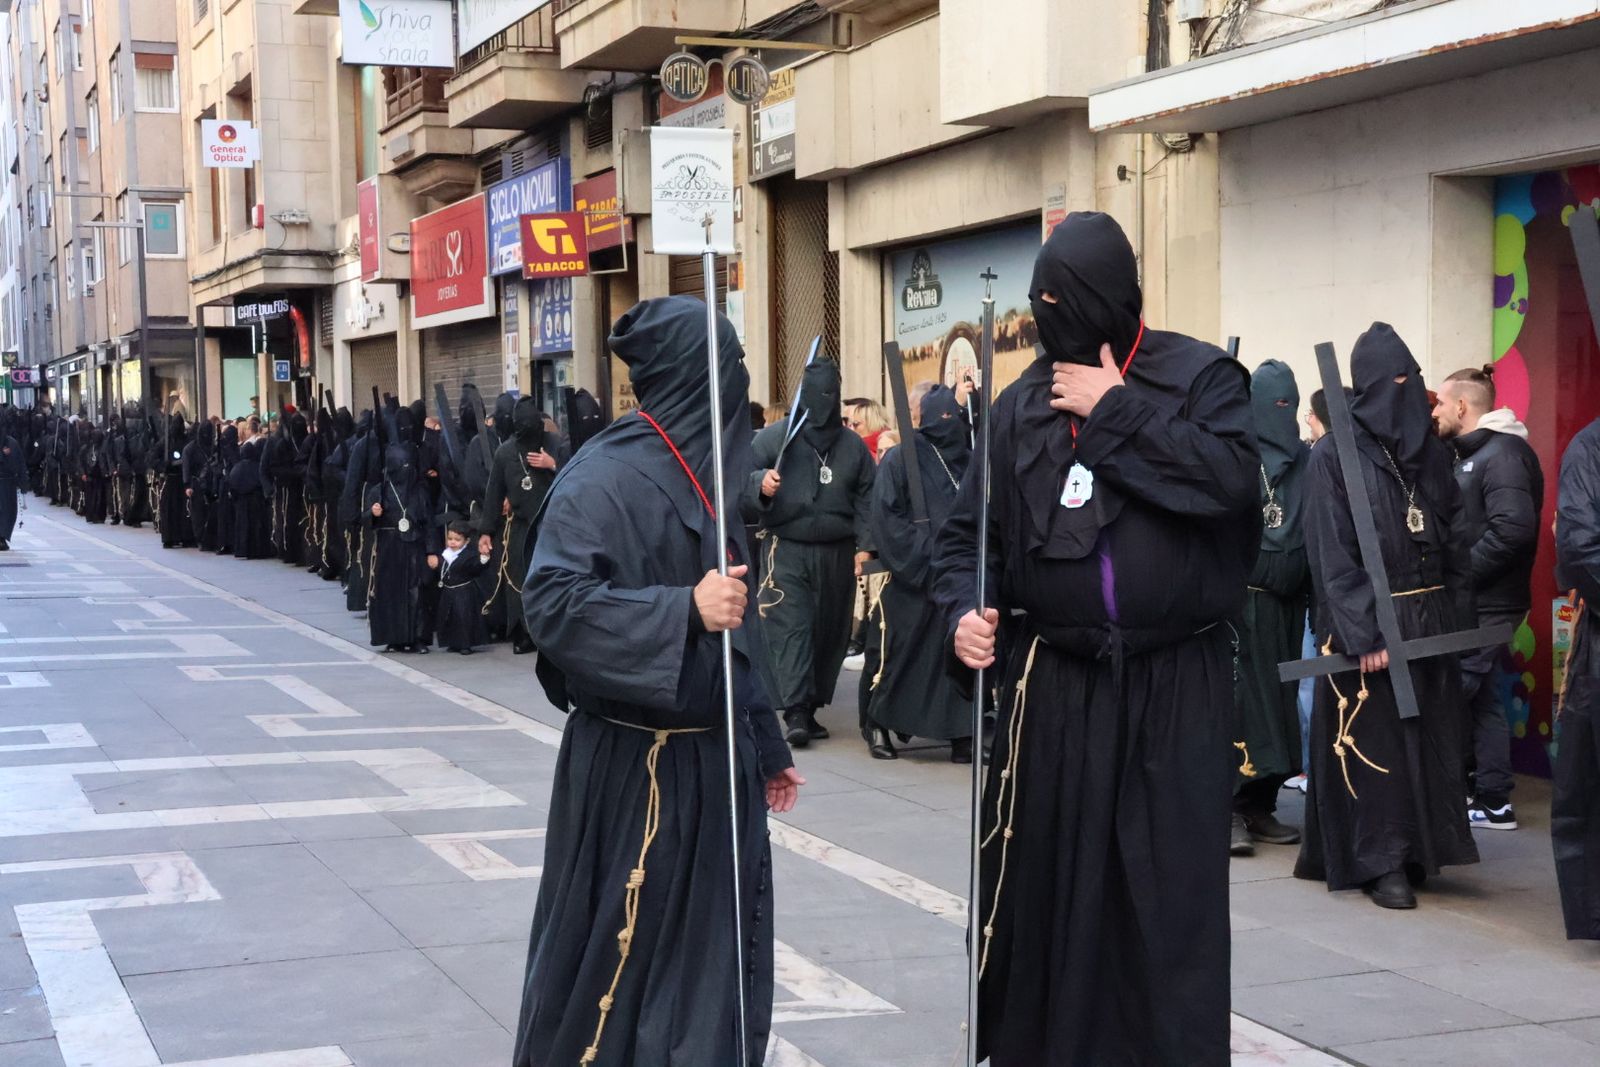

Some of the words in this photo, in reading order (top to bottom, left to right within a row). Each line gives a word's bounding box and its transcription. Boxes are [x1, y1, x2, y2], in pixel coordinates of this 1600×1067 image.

[374, 5, 432, 31] Shiva
[378, 44, 430, 63] shala
[665, 61, 705, 94] OPTICA
[754, 119, 760, 139] 7
[210, 144, 246, 154] General
[213, 153, 244, 163] Optica
[755, 150, 760, 170] 8
[491, 184, 519, 226] SIGLO
[520, 170, 556, 212] MOVIL
[659, 190, 728, 200] IMPOSIBLE
[734, 187, 742, 219] 4
[528, 260, 585, 273] TABACOS
[907, 287, 938, 309] Revilla
[237, 304, 258, 320] CAFE
